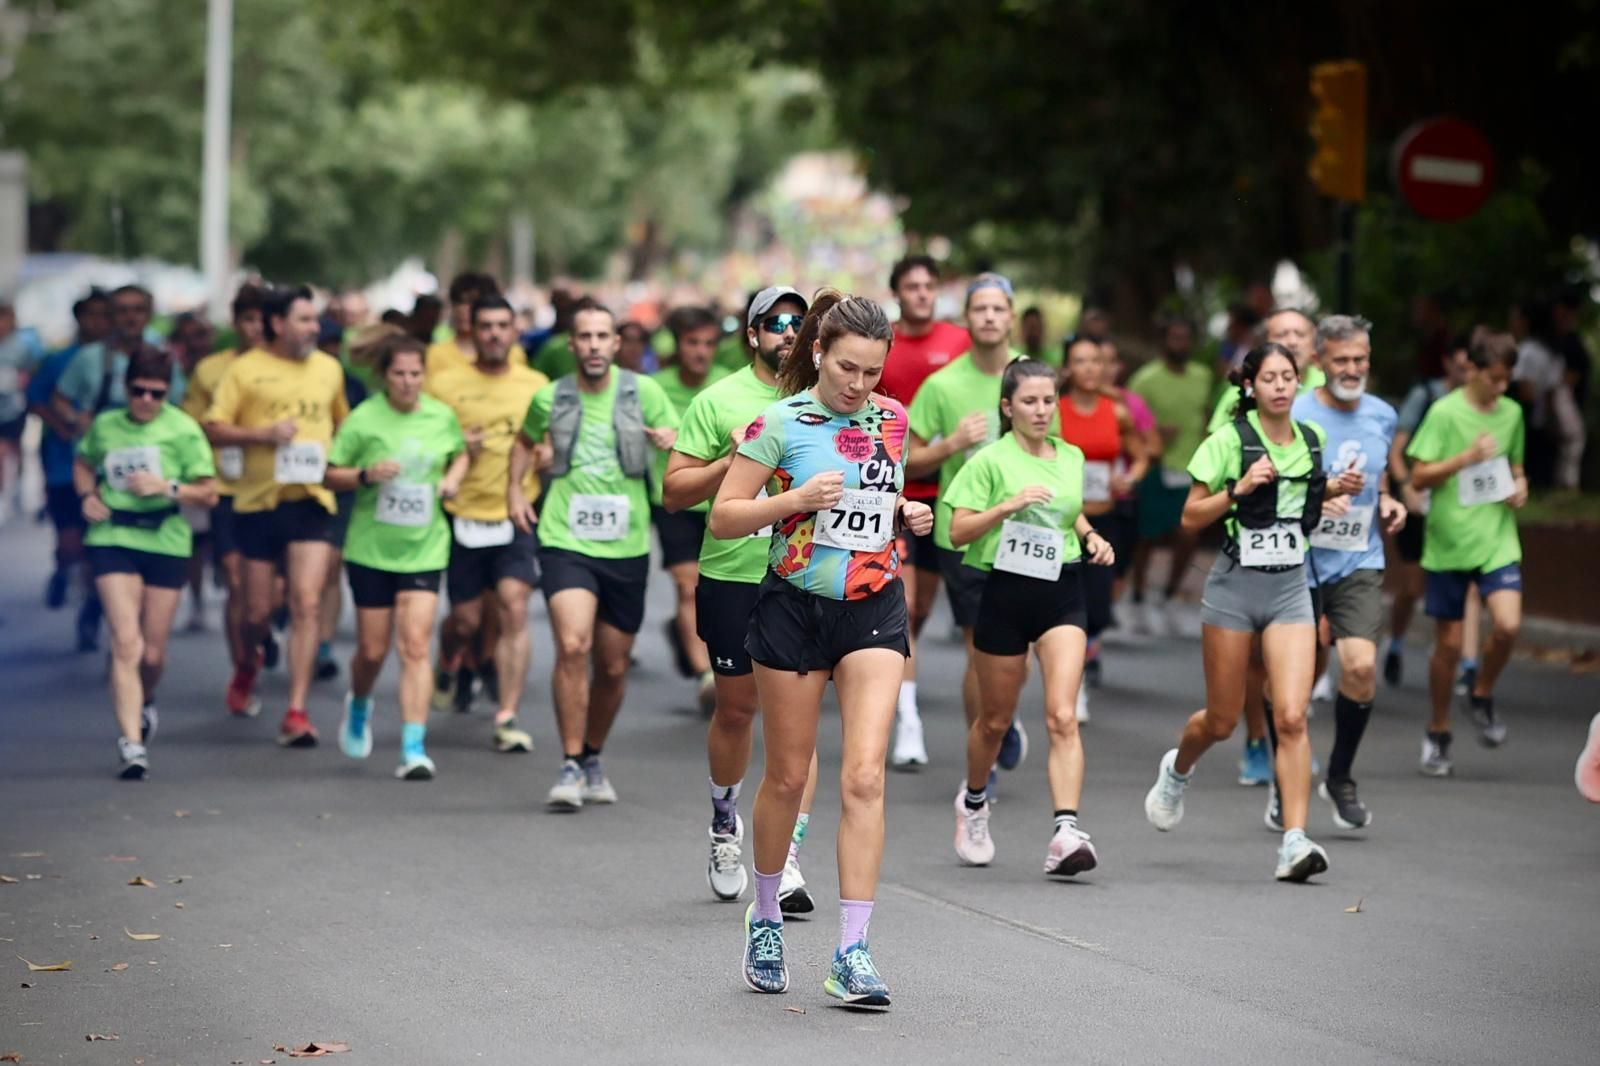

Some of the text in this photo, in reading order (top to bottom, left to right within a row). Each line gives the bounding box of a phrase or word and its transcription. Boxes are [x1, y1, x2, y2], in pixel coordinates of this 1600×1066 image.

[838, 434, 869, 445] Chupa
[838, 443, 869, 455] Chups
[861, 460, 896, 485] Ch
[577, 510, 617, 526] 291
[830, 508, 882, 534] 701
[1321, 519, 1362, 537] 238
[1006, 538, 1056, 560] 1158
